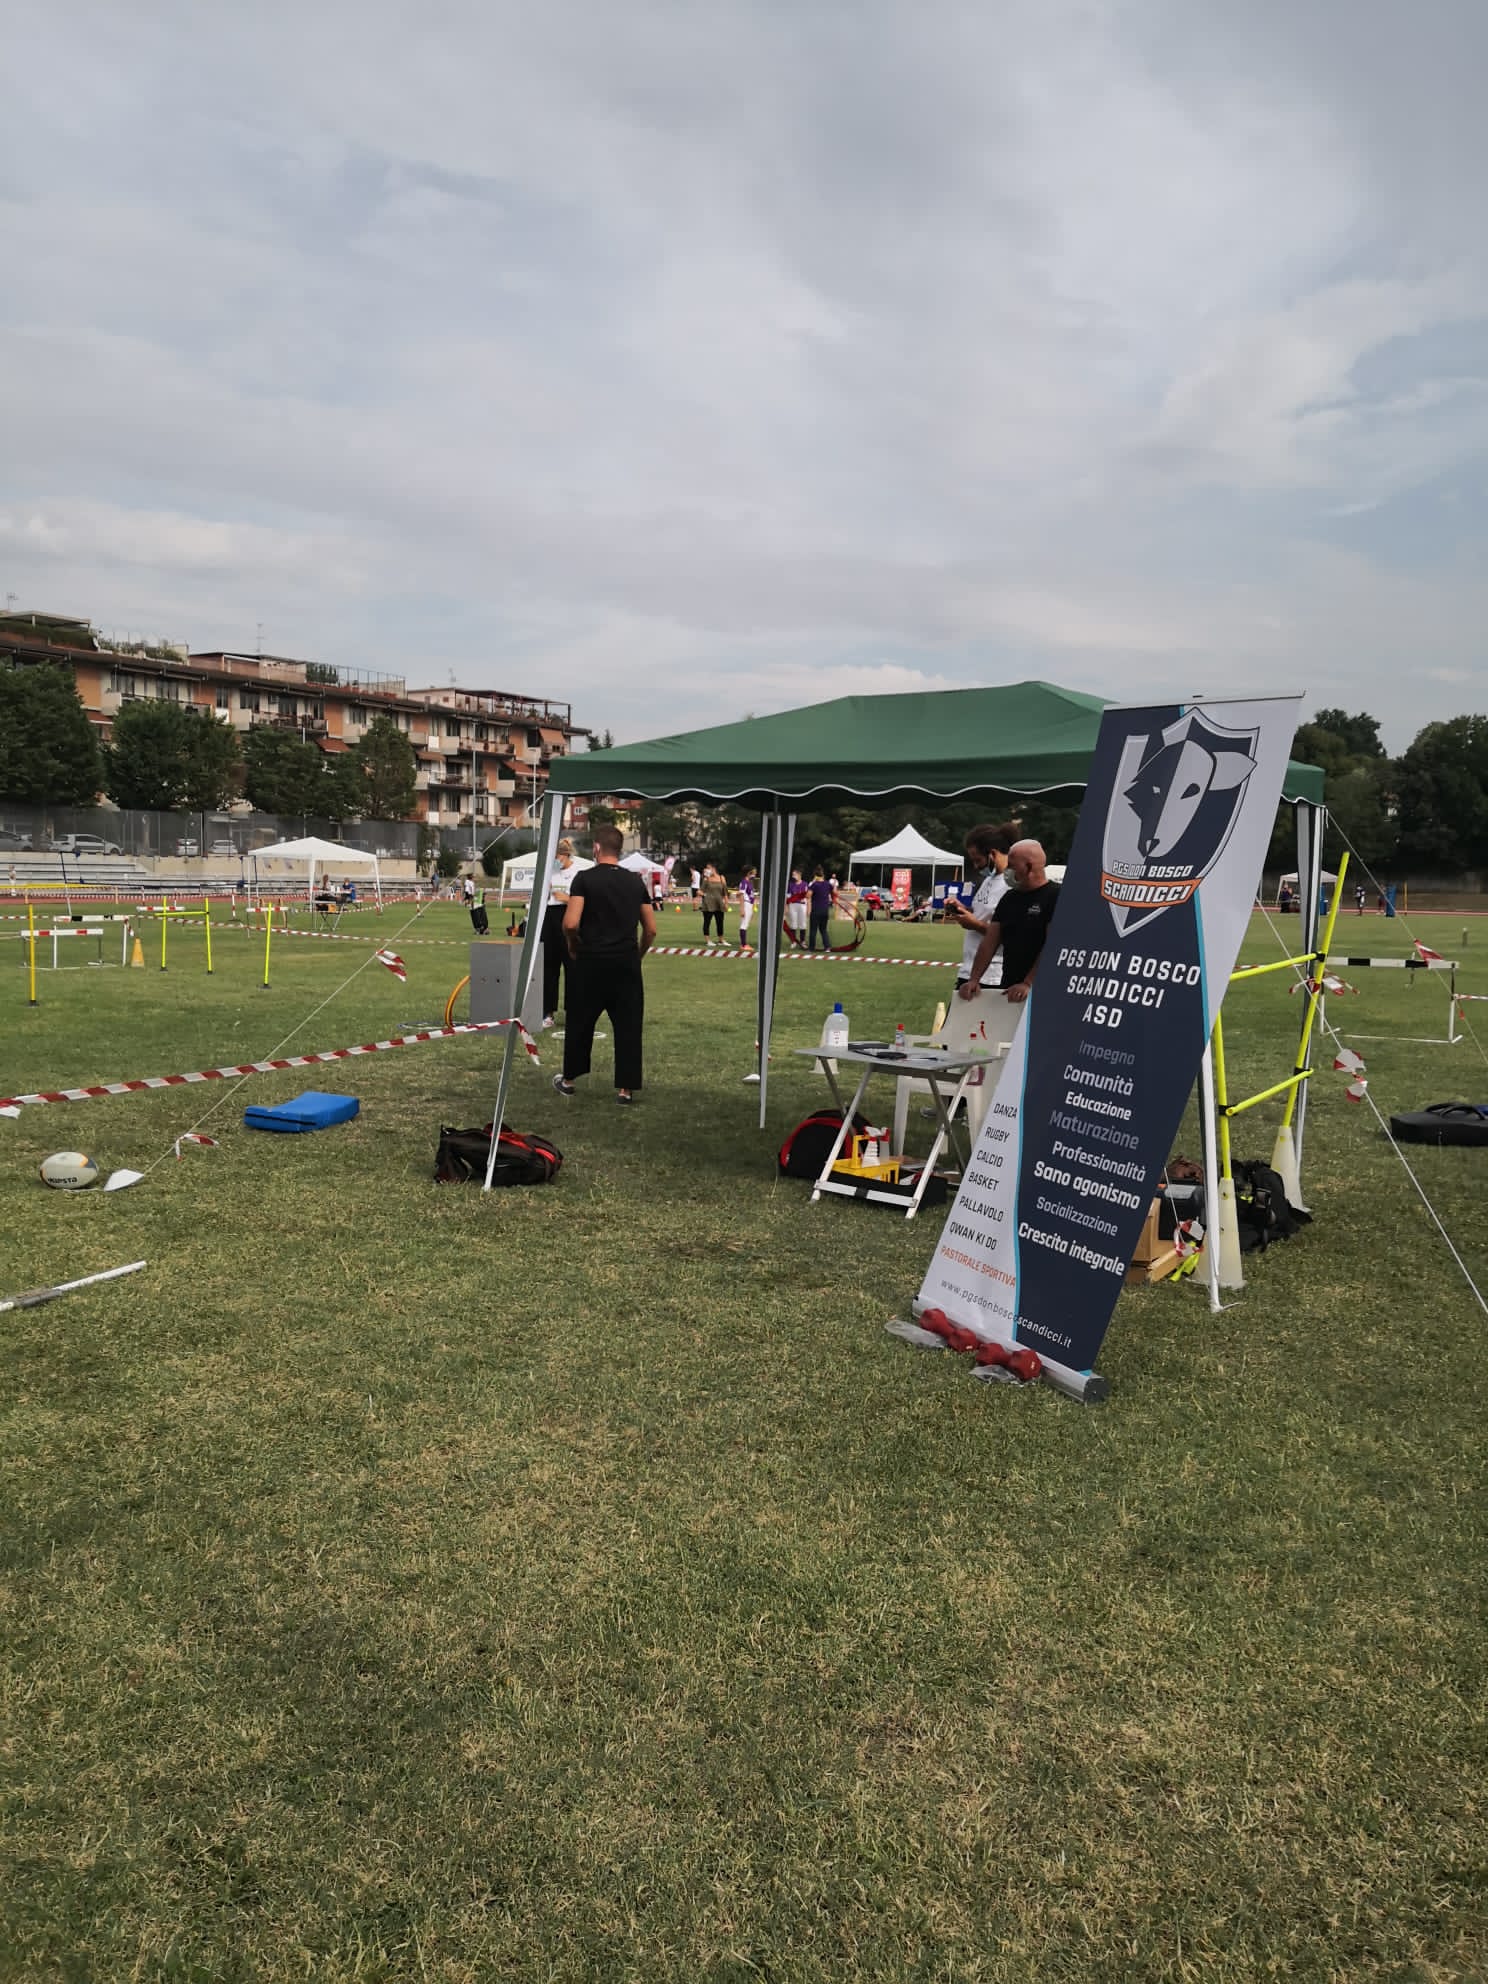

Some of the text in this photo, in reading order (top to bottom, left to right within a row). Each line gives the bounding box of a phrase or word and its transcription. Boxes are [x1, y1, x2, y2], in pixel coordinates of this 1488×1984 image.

[1112, 861, 1130, 876] PGS
[1147, 865, 1194, 878] BOSCO
[1103, 879, 1192, 903] SCANDICCI
[1056, 948, 1201, 986] PGS DON BOSCO
[1066, 975, 1165, 1009] SCANDICCI
[1081, 1003, 1123, 1028] ASD
[1079, 1039, 1136, 1065] Impegno
[1063, 1064, 1134, 1096] Comunità
[993, 1103, 1018, 1119] DANZA
[1065, 1091, 1132, 1121] Educazione
[985, 1126, 1010, 1143] RUGBY
[1049, 1110, 1140, 1150] Maturazione
[976, 1150, 1004, 1168] CALCIO
[1051, 1140, 1147, 1183] Professionalità
[968, 1171, 1000, 1191] BASKET
[1033, 1160, 1141, 1210] Sano agonismo
[959, 1195, 1004, 1222] PALLAVOLO
[1036, 1196, 1119, 1238] Socializzazione
[975, 1231, 986, 1246] KI
[985, 1236, 998, 1251] DO
[1018, 1221, 1126, 1276] Crescita integrale
[940, 1245, 1017, 1289] PASTORALE SPORTIVA
